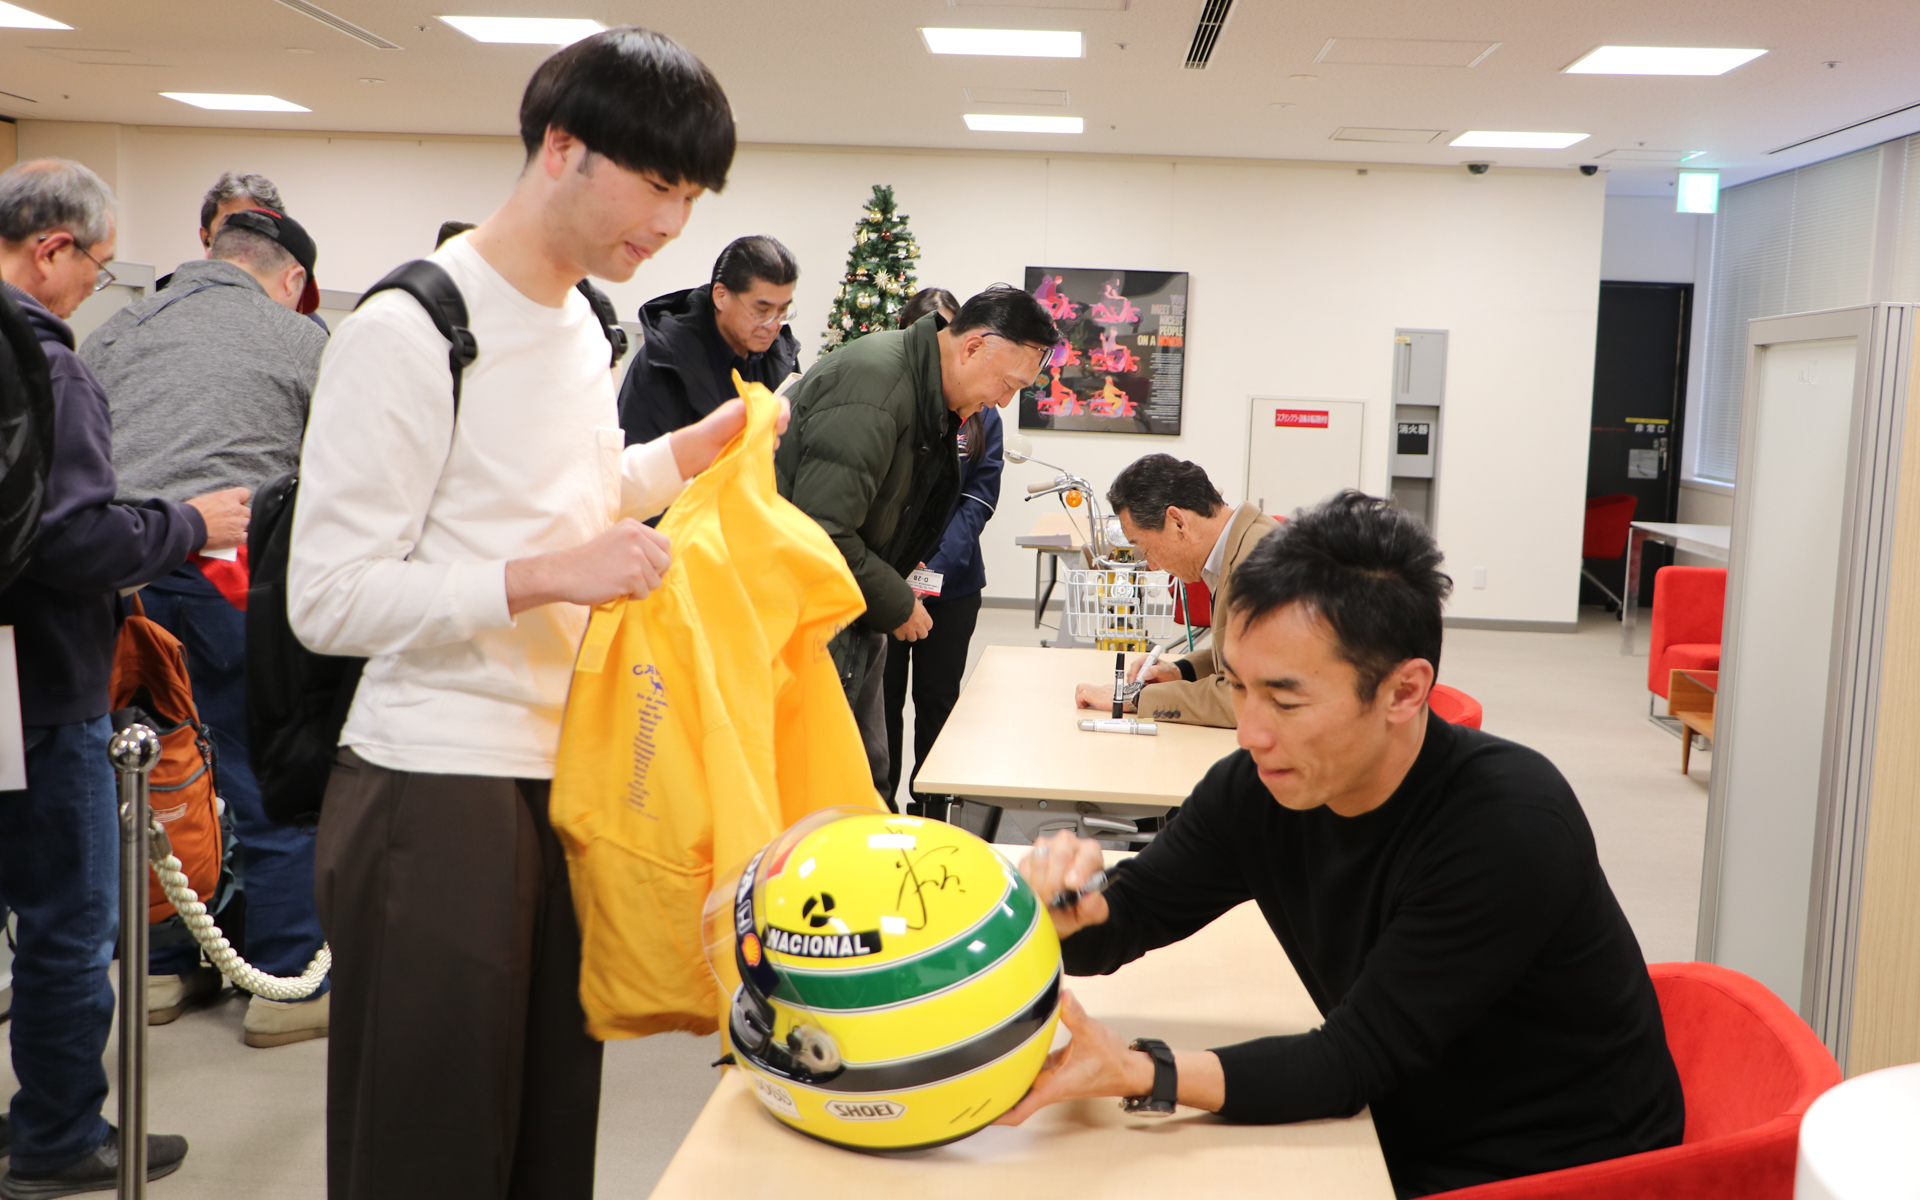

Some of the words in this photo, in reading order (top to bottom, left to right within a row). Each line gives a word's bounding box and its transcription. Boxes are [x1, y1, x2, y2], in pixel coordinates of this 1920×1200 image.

[1170, 294, 1185, 304] YOU
[1151, 304, 1170, 315] MEET
[1172, 305, 1185, 315] THE
[1159, 315, 1184, 326] NICEST
[1159, 326, 1184, 336] PEOPLE
[1137, 335, 1149, 346] ON
[1149, 335, 1156, 346] A
[1157, 336, 1183, 347] HONDA
[1398, 425, 1428, 435] 消火器
[1635, 424, 1666, 433] 非常口
[766, 928, 870, 957] NACIONAL
[834, 1104, 895, 1117] SHOEI
